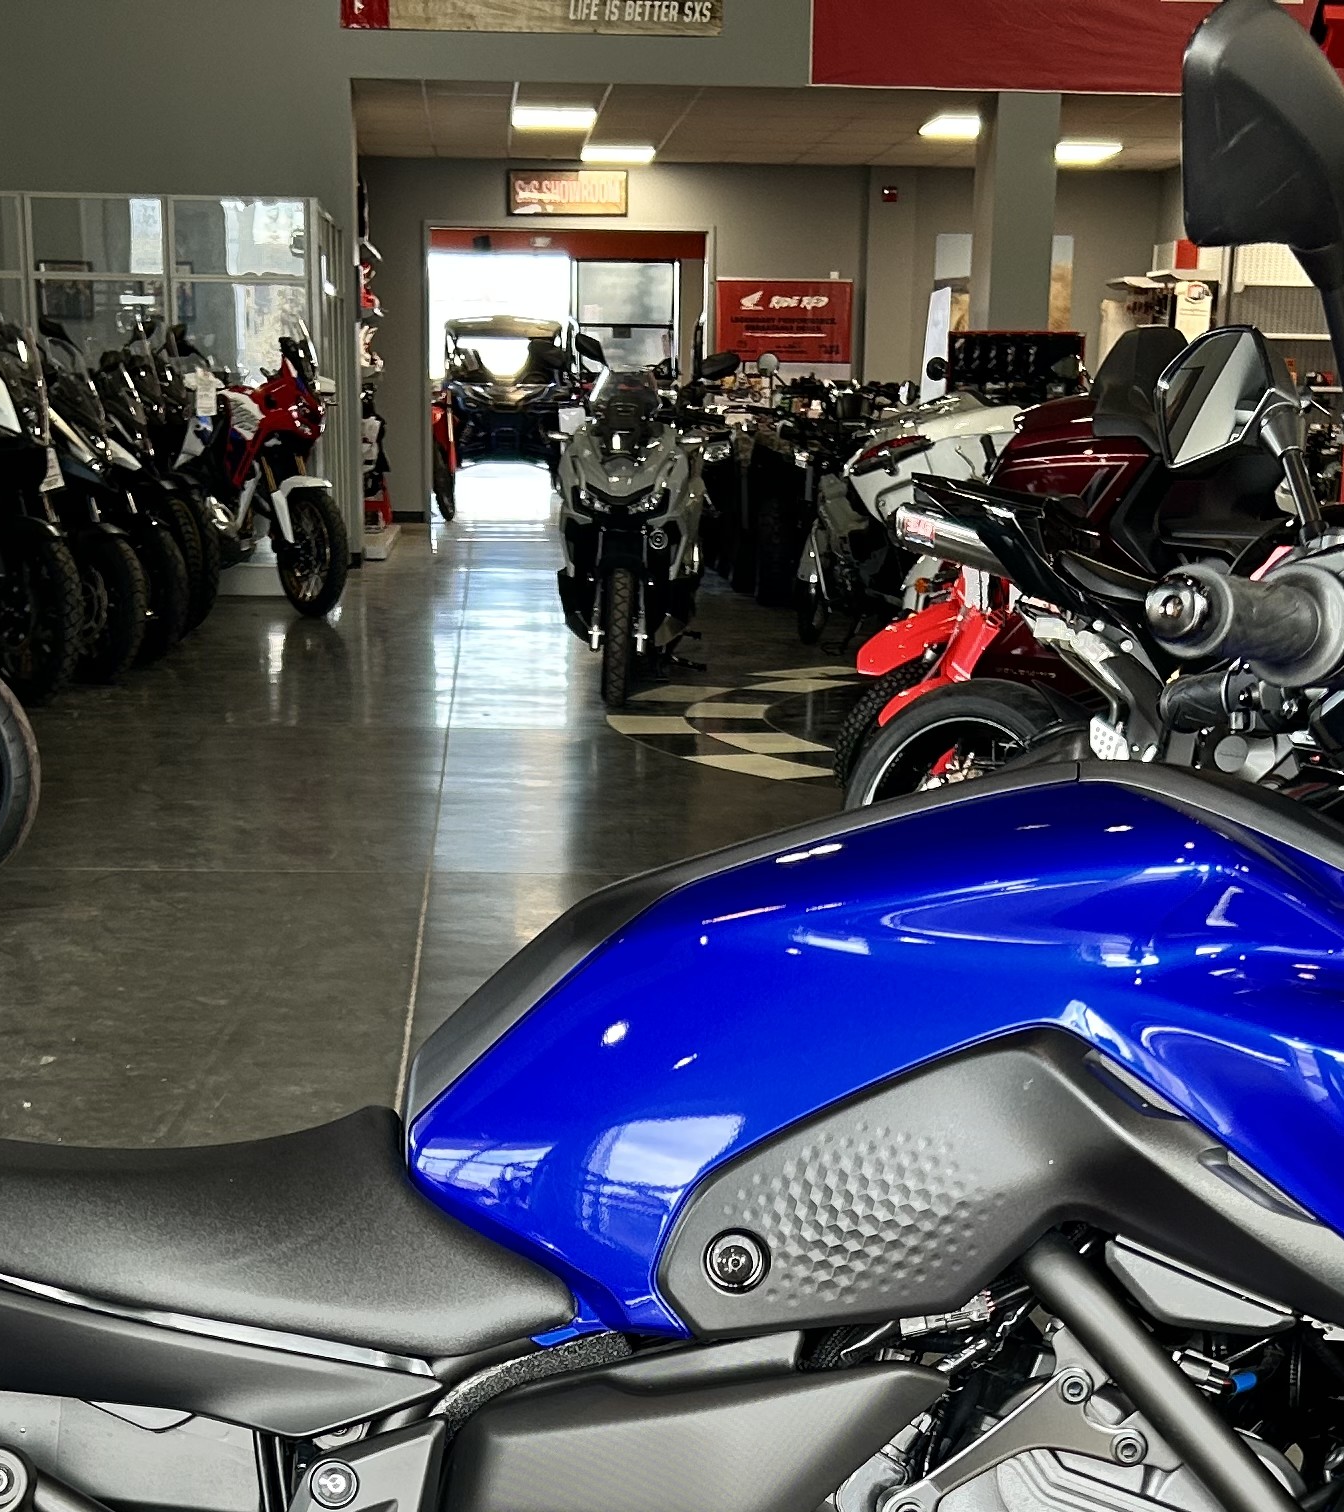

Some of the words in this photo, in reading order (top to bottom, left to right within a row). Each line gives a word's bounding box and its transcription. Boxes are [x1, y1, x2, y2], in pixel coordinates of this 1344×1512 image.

[568, 0, 599, 21] LIFE
[605, 1, 619, 21] IS
[623, 1, 679, 22] BETTER
[683, 2, 711, 23] SXS
[542, 180, 621, 203] SHOWROOM
